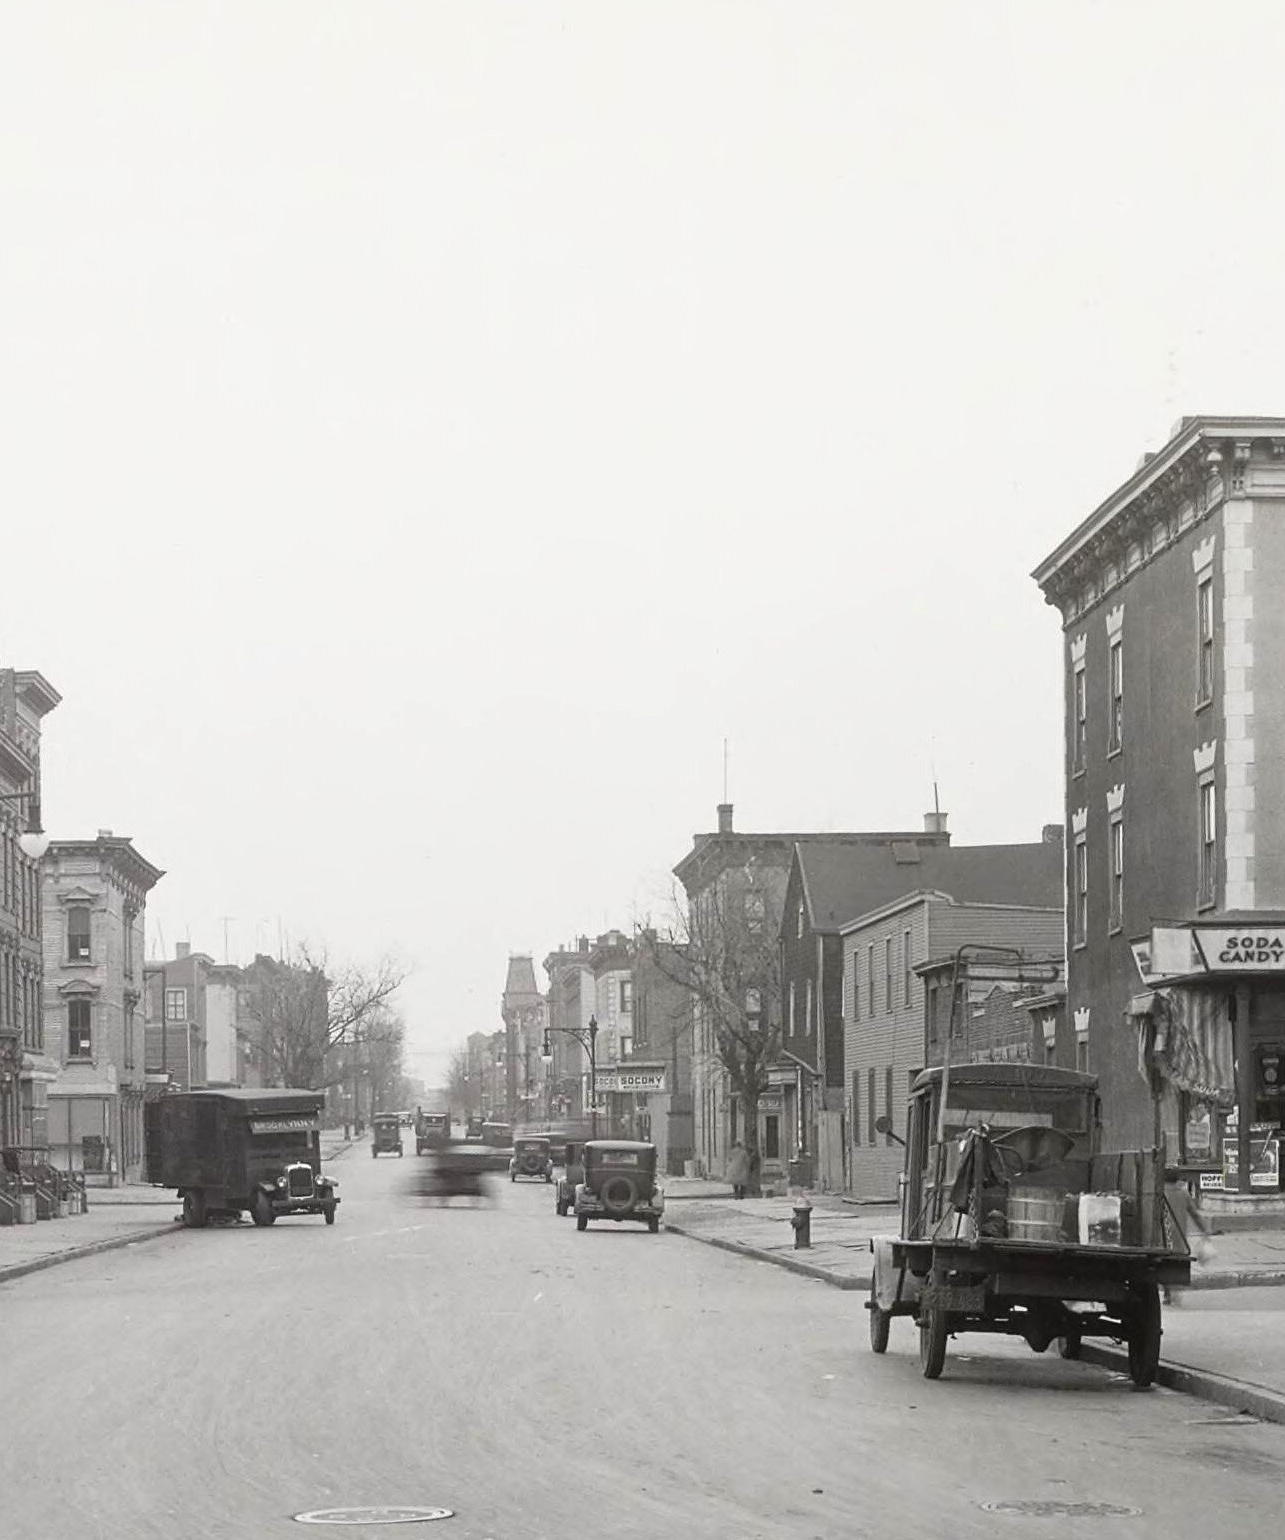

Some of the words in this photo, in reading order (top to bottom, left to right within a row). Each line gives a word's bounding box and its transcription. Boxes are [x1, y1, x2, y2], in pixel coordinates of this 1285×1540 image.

[1226, 936, 1284, 949] SODA
[1218, 950, 1285, 963] CANDY
[620, 1076, 662, 1085] SOCONY
